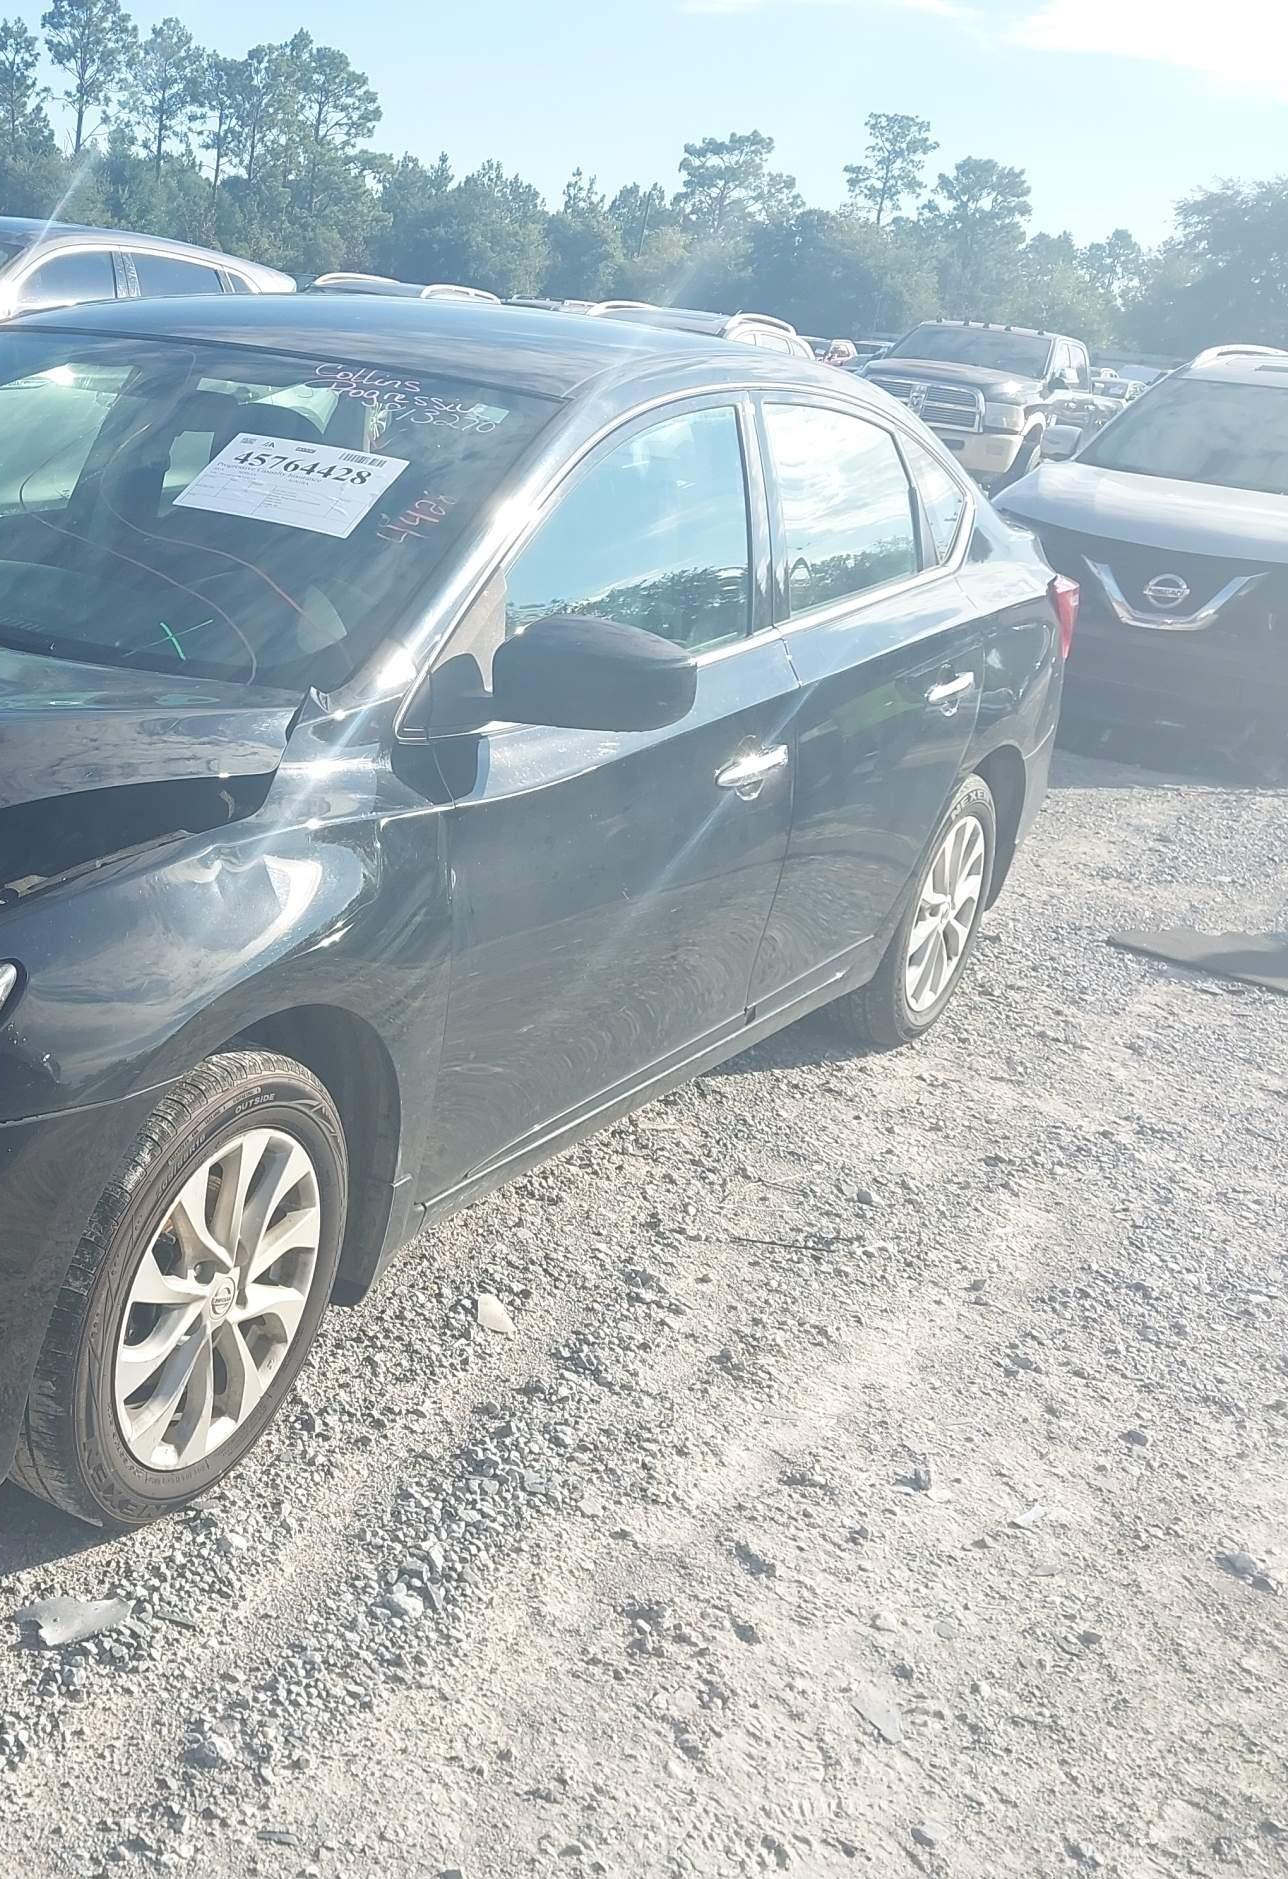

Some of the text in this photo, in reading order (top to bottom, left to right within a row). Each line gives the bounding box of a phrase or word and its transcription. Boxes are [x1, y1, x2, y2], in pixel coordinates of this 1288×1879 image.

[315, 362, 421, 392] Collins
[233, 451, 372, 486] 45764428
[234, 1093, 276, 1114] OUTSIDE
